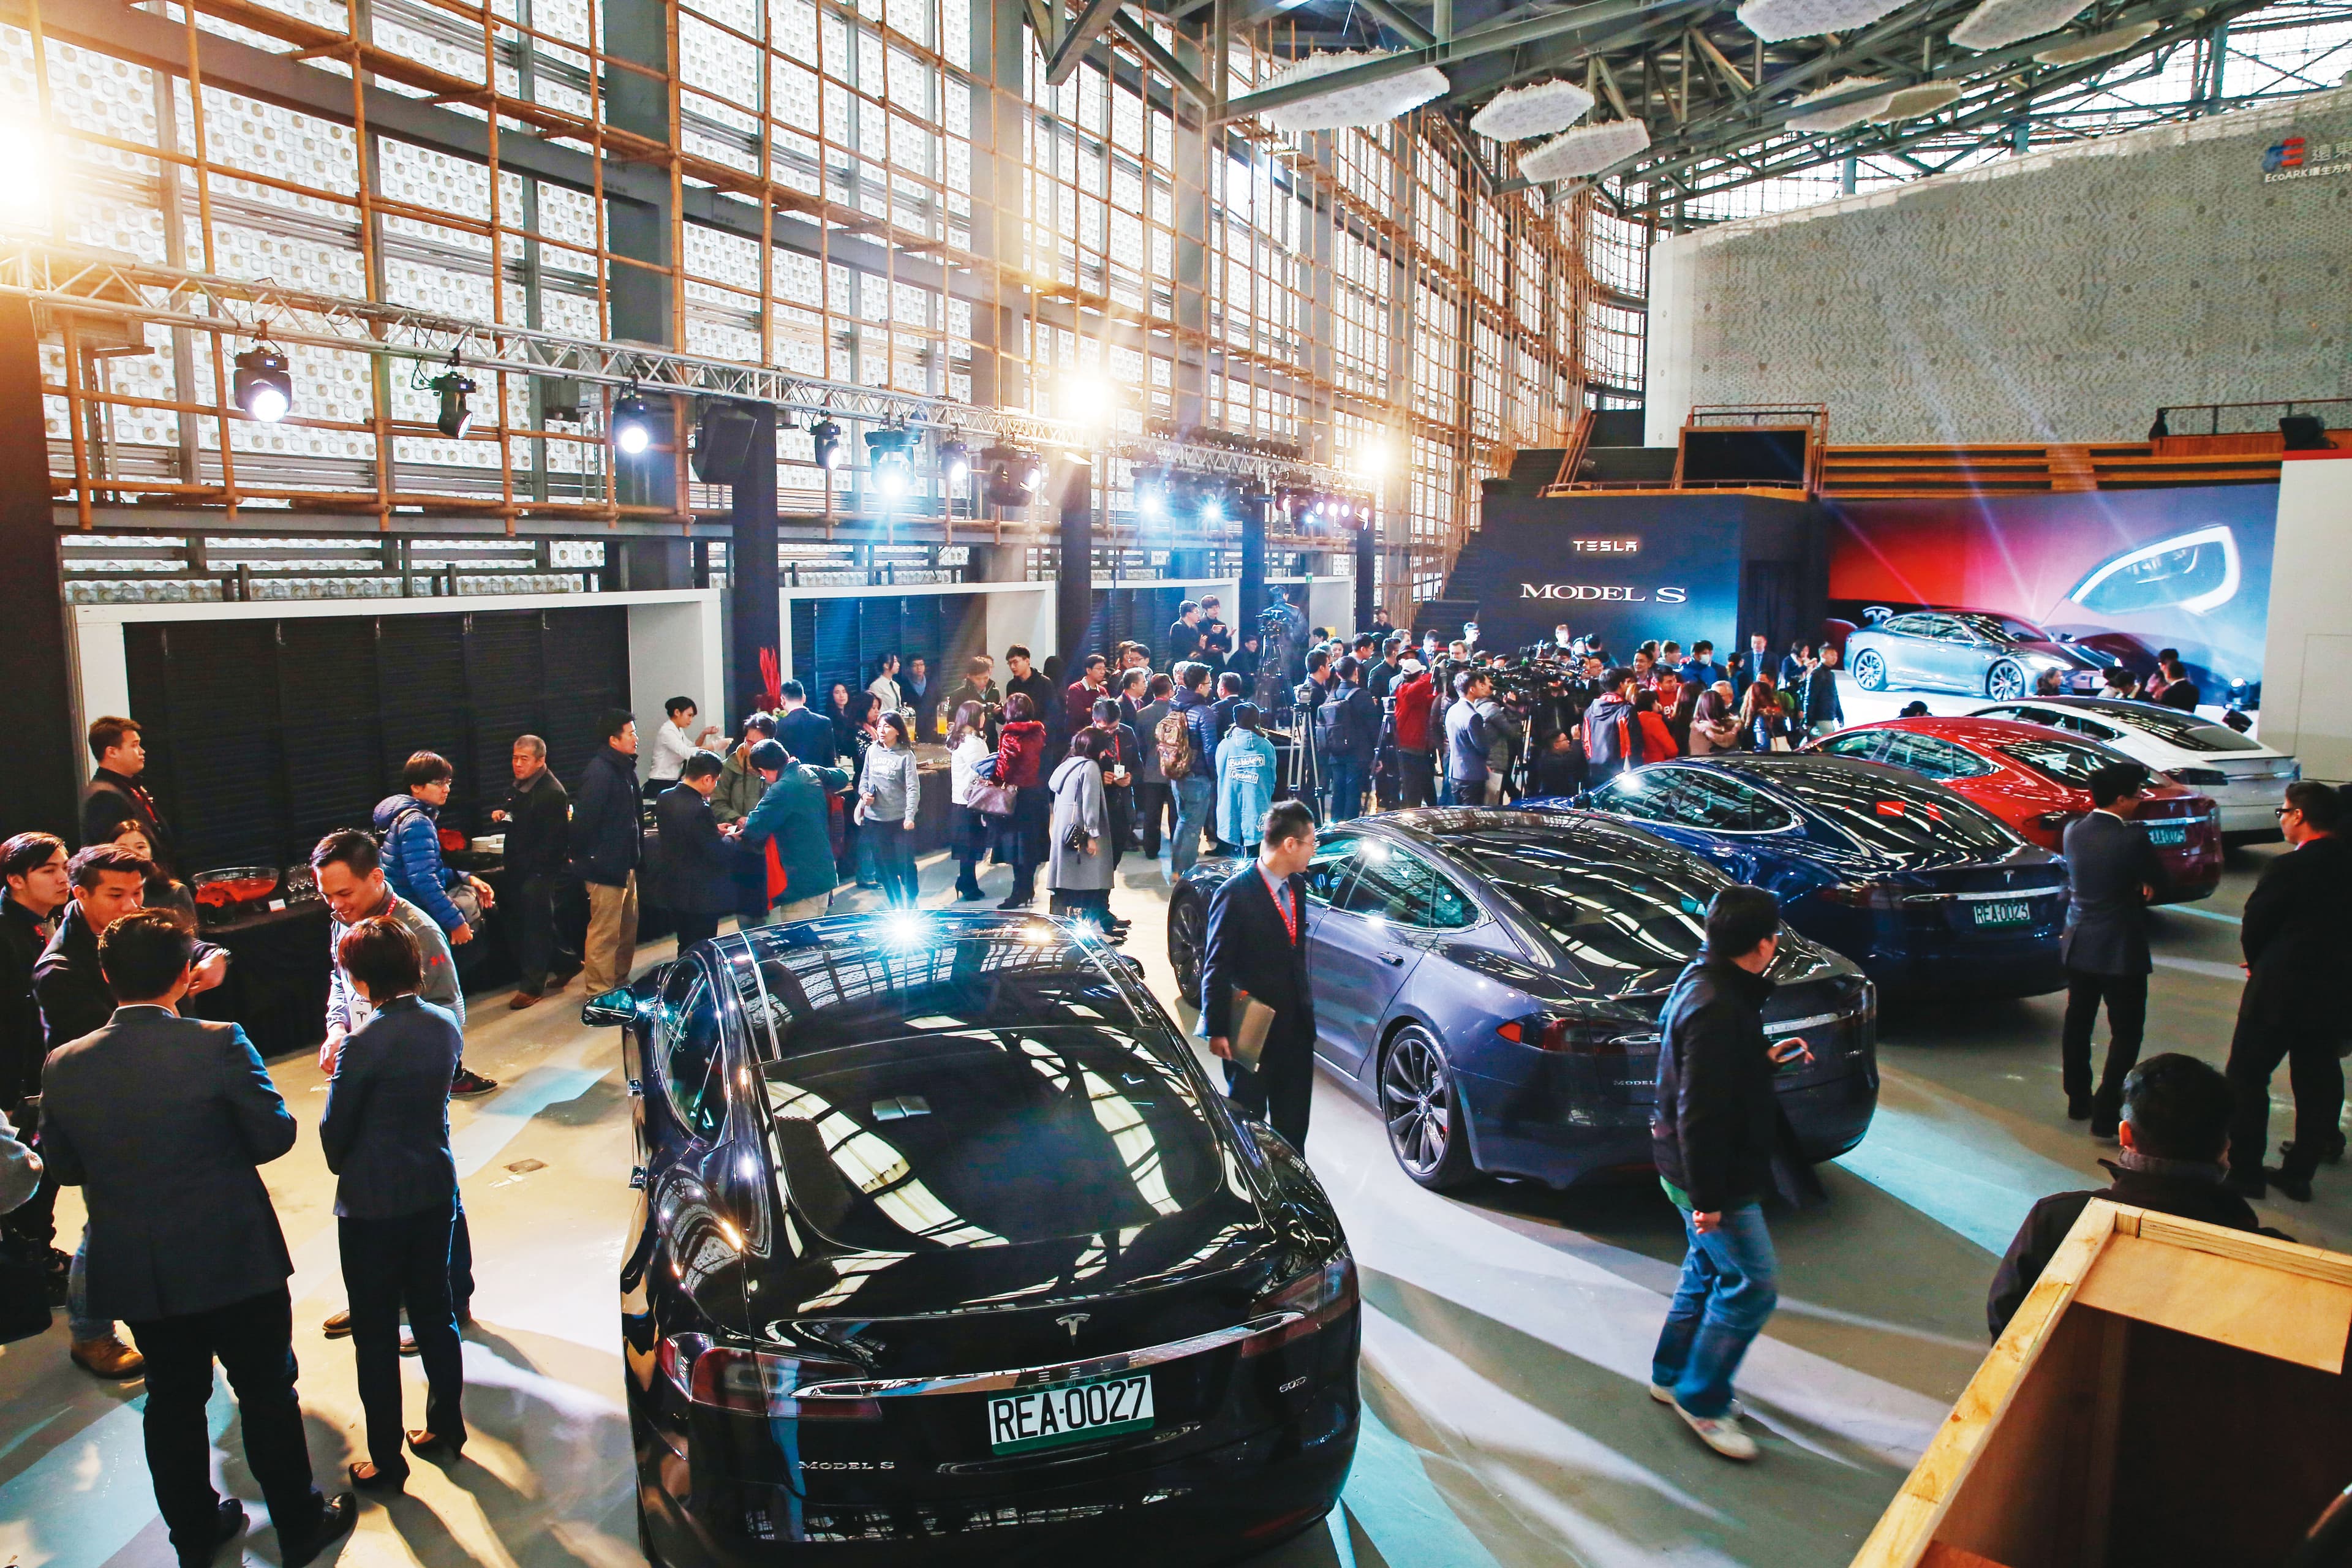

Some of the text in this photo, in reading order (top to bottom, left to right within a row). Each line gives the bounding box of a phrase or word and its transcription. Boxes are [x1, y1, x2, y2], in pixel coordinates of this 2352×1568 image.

[1572, 540, 1638, 552] TESLA
[1519, 583, 1686, 603] MODEL S
[872, 757, 897, 768] ROOTS
[798, 1461, 874, 1469] MODEL
